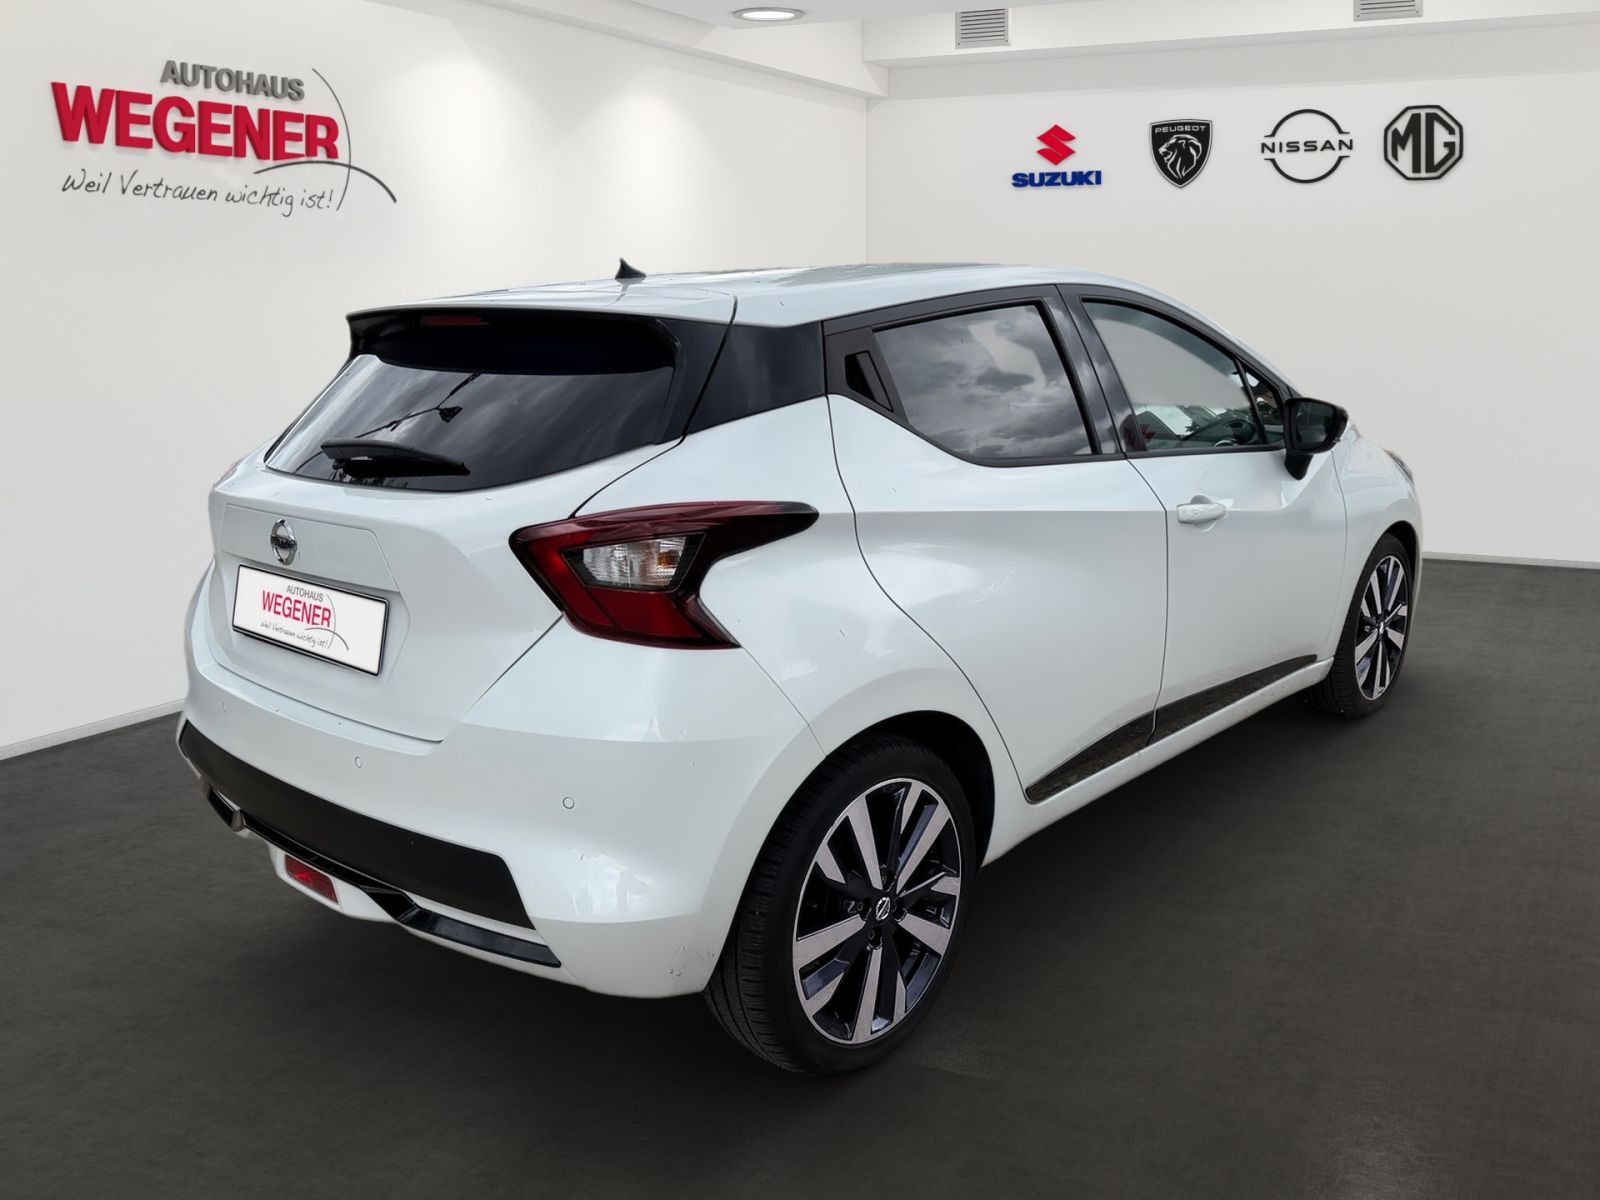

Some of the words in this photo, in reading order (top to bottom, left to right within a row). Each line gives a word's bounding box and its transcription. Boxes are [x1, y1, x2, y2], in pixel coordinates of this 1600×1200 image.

[160, 60, 305, 101] AUTOHAUS
[51, 82, 340, 161] WEGENER
[1154, 124, 1207, 134] PEUGEOT
[1261, 138, 1354, 154] NISSAN
[1391, 111, 1456, 175] MG
[62, 168, 112, 194] Weil
[120, 169, 218, 202] Vertrauen
[225, 184, 294, 218] wichtig
[300, 189, 334, 210] ist!
[1012, 170, 1102, 188] SUZUKI
[262, 590, 332, 628] WEGENER
[286, 584, 324, 603] AUTOHAUS
